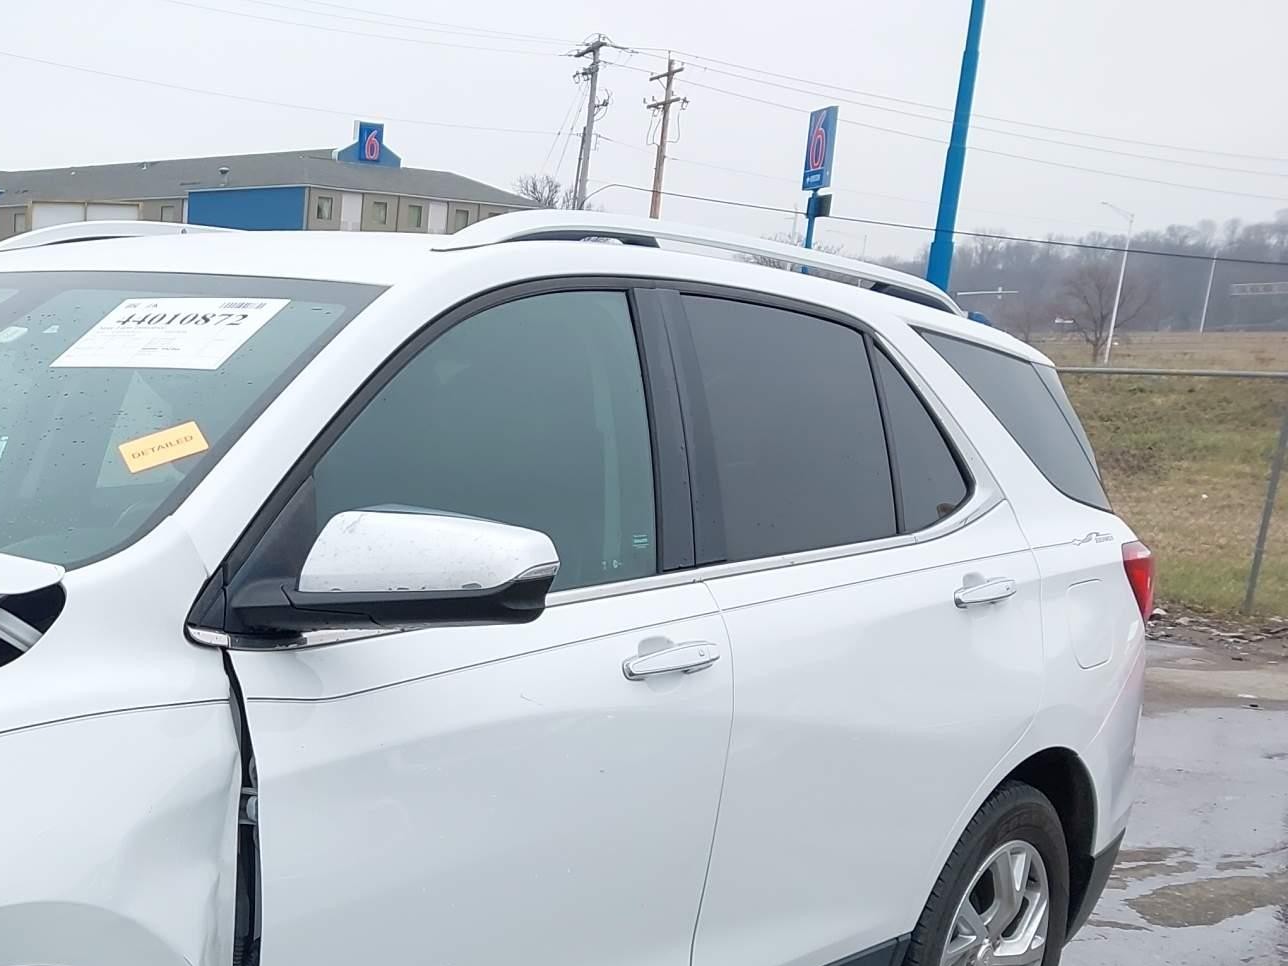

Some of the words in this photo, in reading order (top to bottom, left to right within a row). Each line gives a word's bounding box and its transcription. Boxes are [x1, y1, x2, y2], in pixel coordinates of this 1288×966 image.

[365, 129, 380, 161] 6
[810, 110, 825, 170] 6
[115, 312, 248, 326] 44010872
[131, 435, 193, 459] DETAILED
